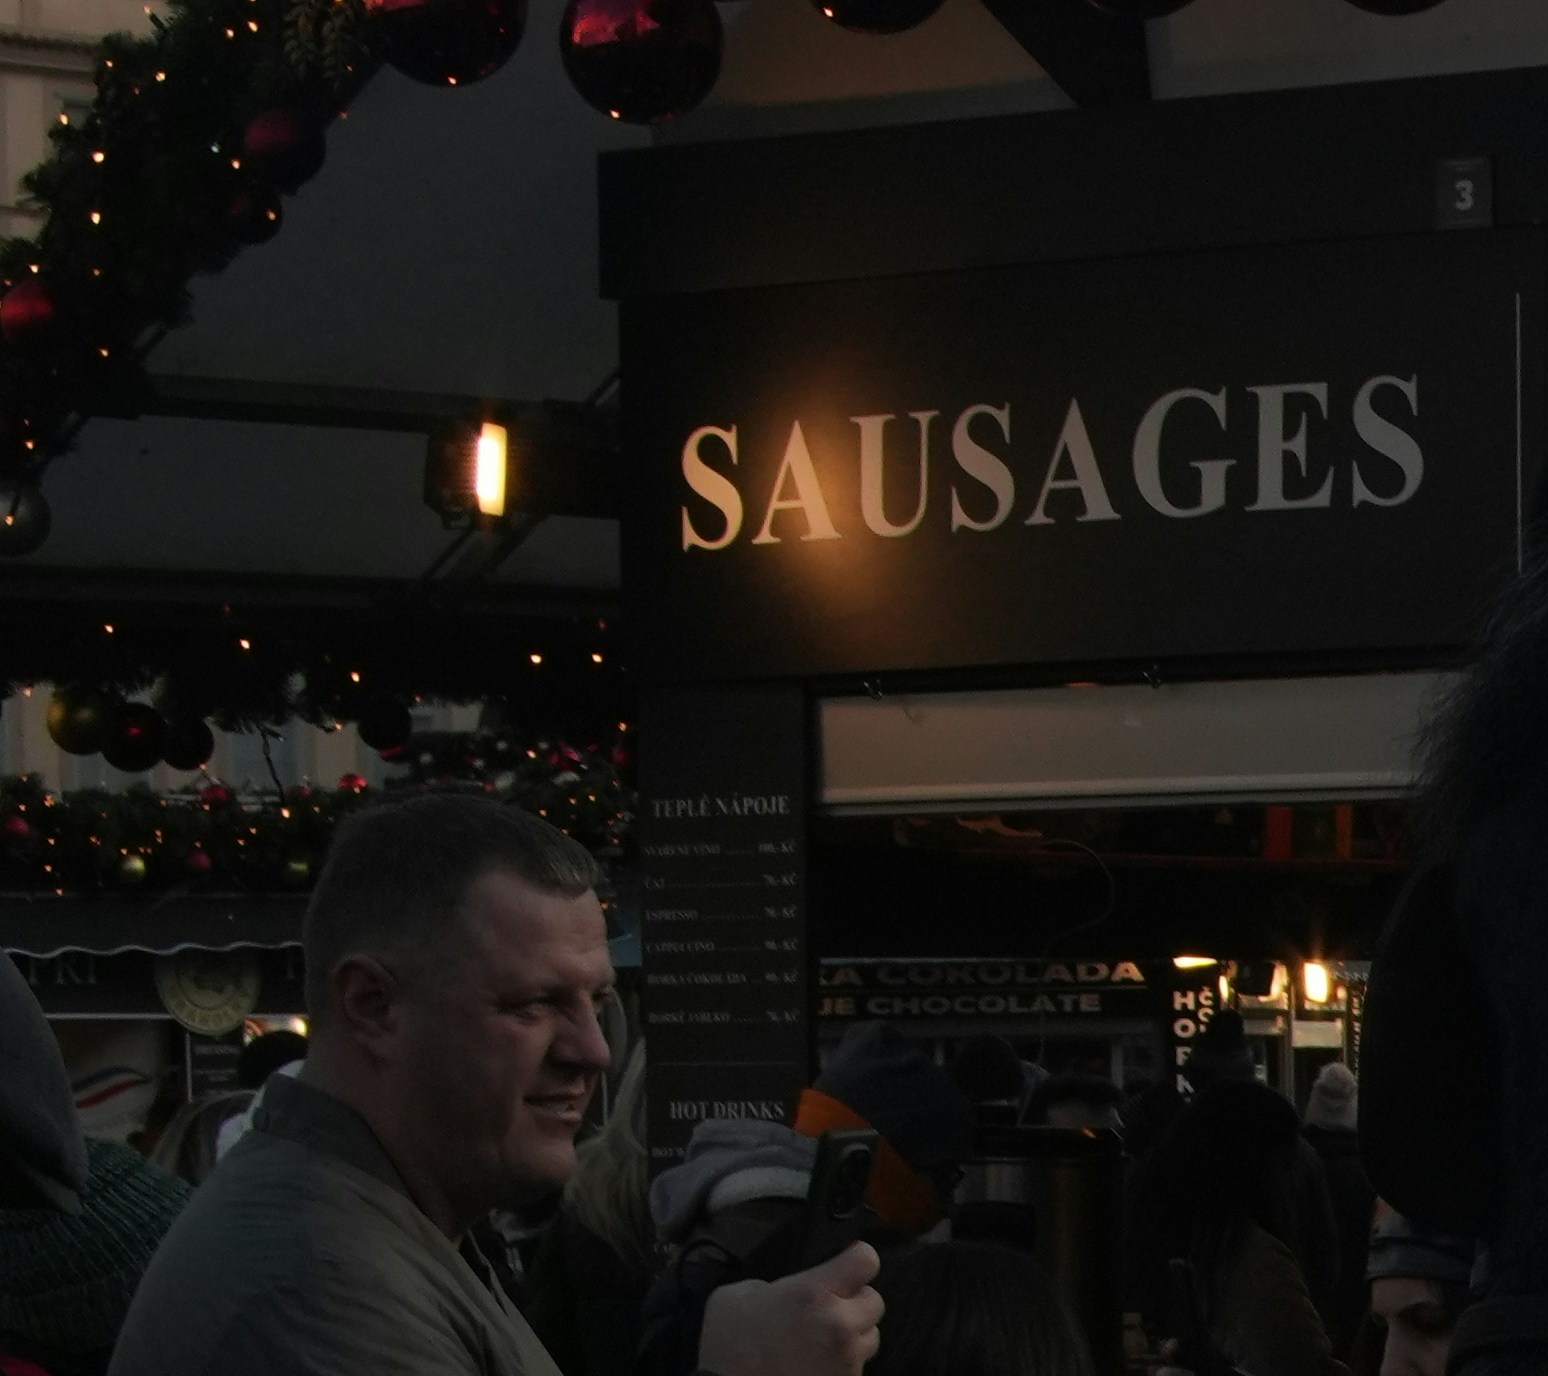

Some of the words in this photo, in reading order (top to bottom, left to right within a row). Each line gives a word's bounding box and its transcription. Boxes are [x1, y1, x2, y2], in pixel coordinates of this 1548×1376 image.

[1454, 179, 1474, 212] 3
[680, 372, 1426, 552] SAUSAGES
[652, 793, 711, 818] TEPLÉ
[715, 792, 791, 816] NÁPOJE
[866, 993, 1102, 1016] CHOCOLATE
[670, 1101, 709, 1120] HOT
[712, 1100, 785, 1120] DRINKS
